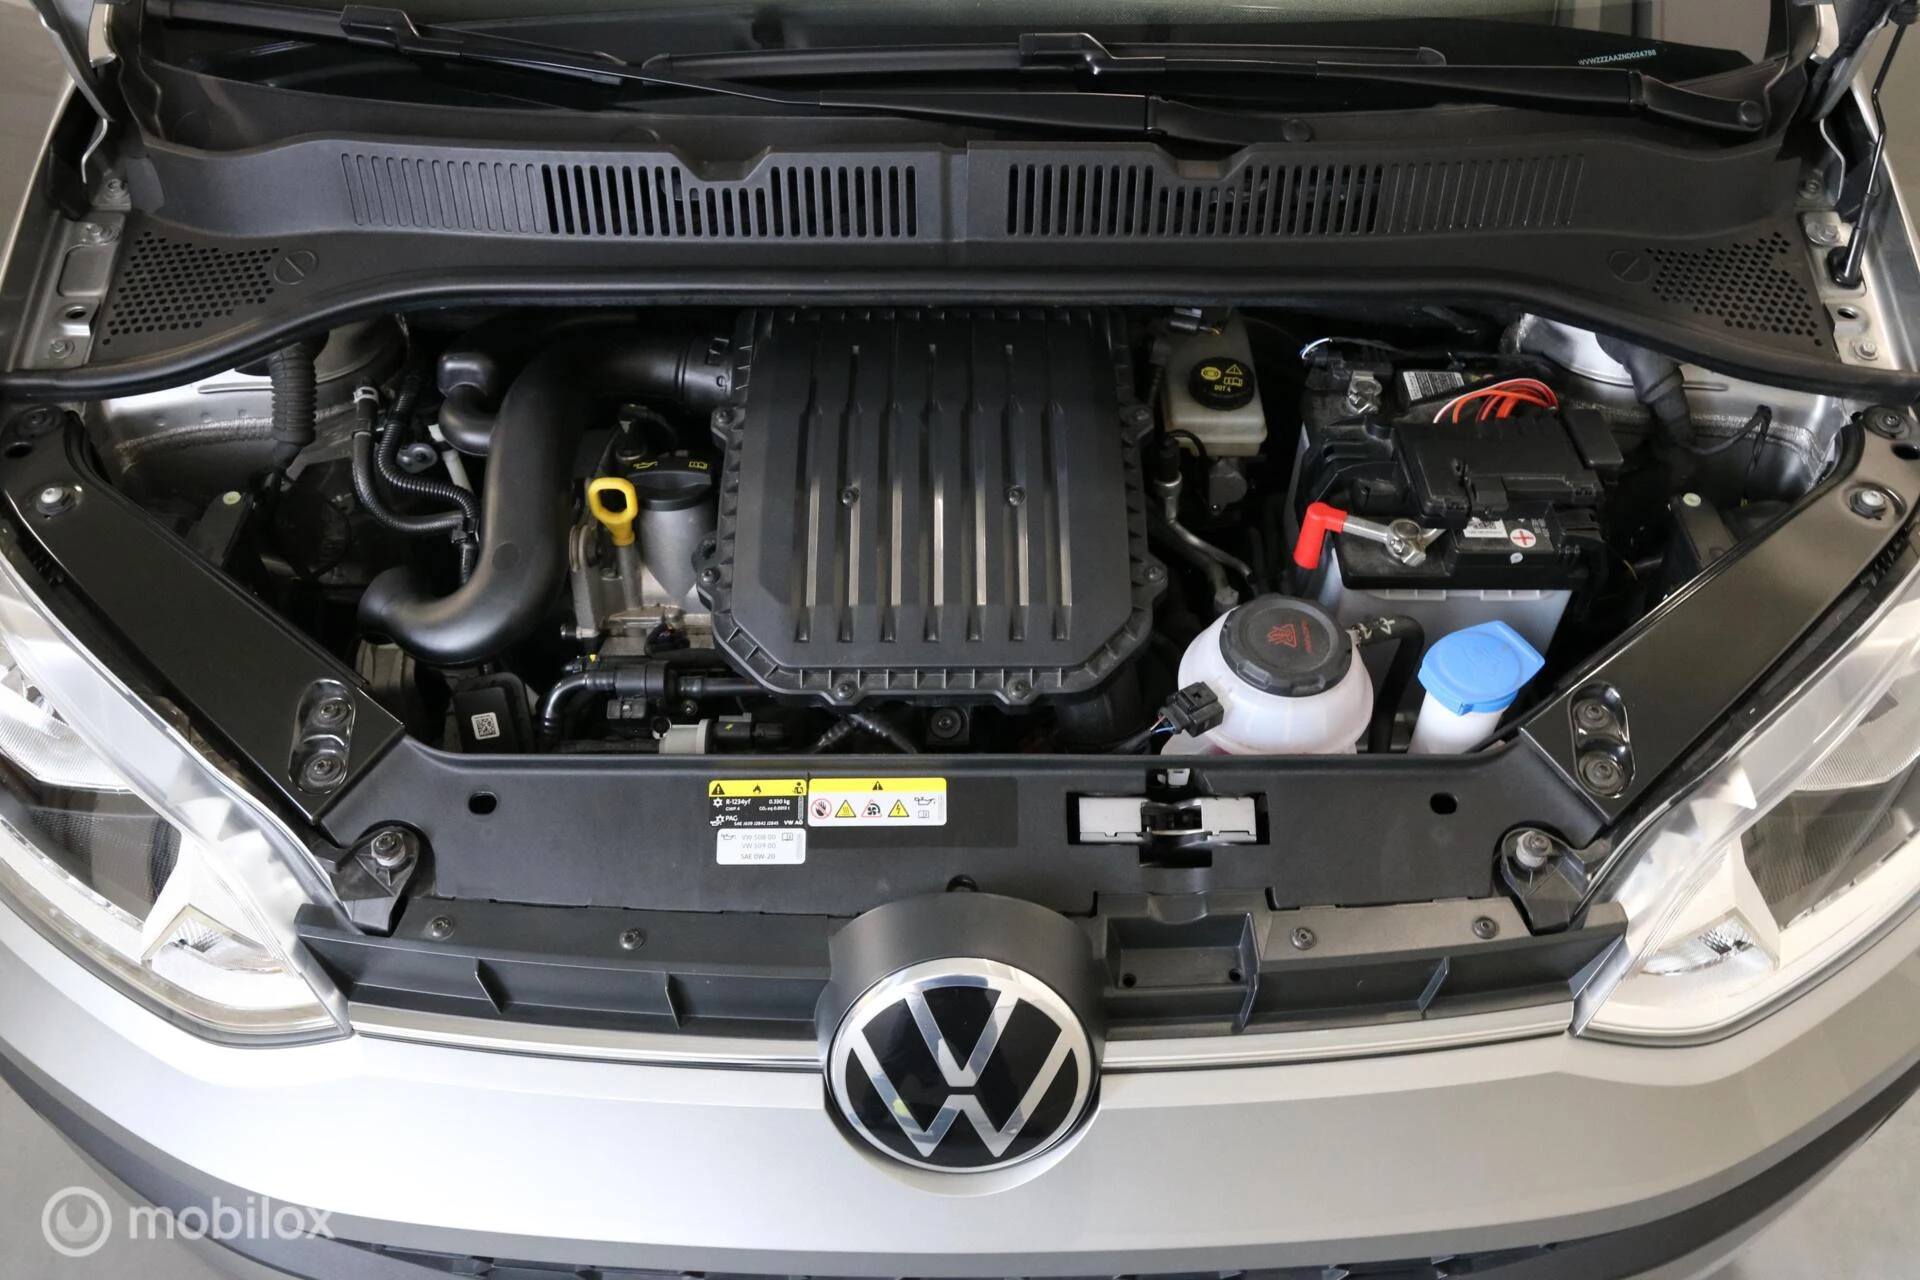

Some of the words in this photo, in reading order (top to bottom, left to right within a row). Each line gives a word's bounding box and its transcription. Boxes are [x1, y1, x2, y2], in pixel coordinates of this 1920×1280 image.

[1214, 384, 1226, 392] DOT
[725, 798, 751, 806] R-1234yf
[784, 798, 790, 806] kg
